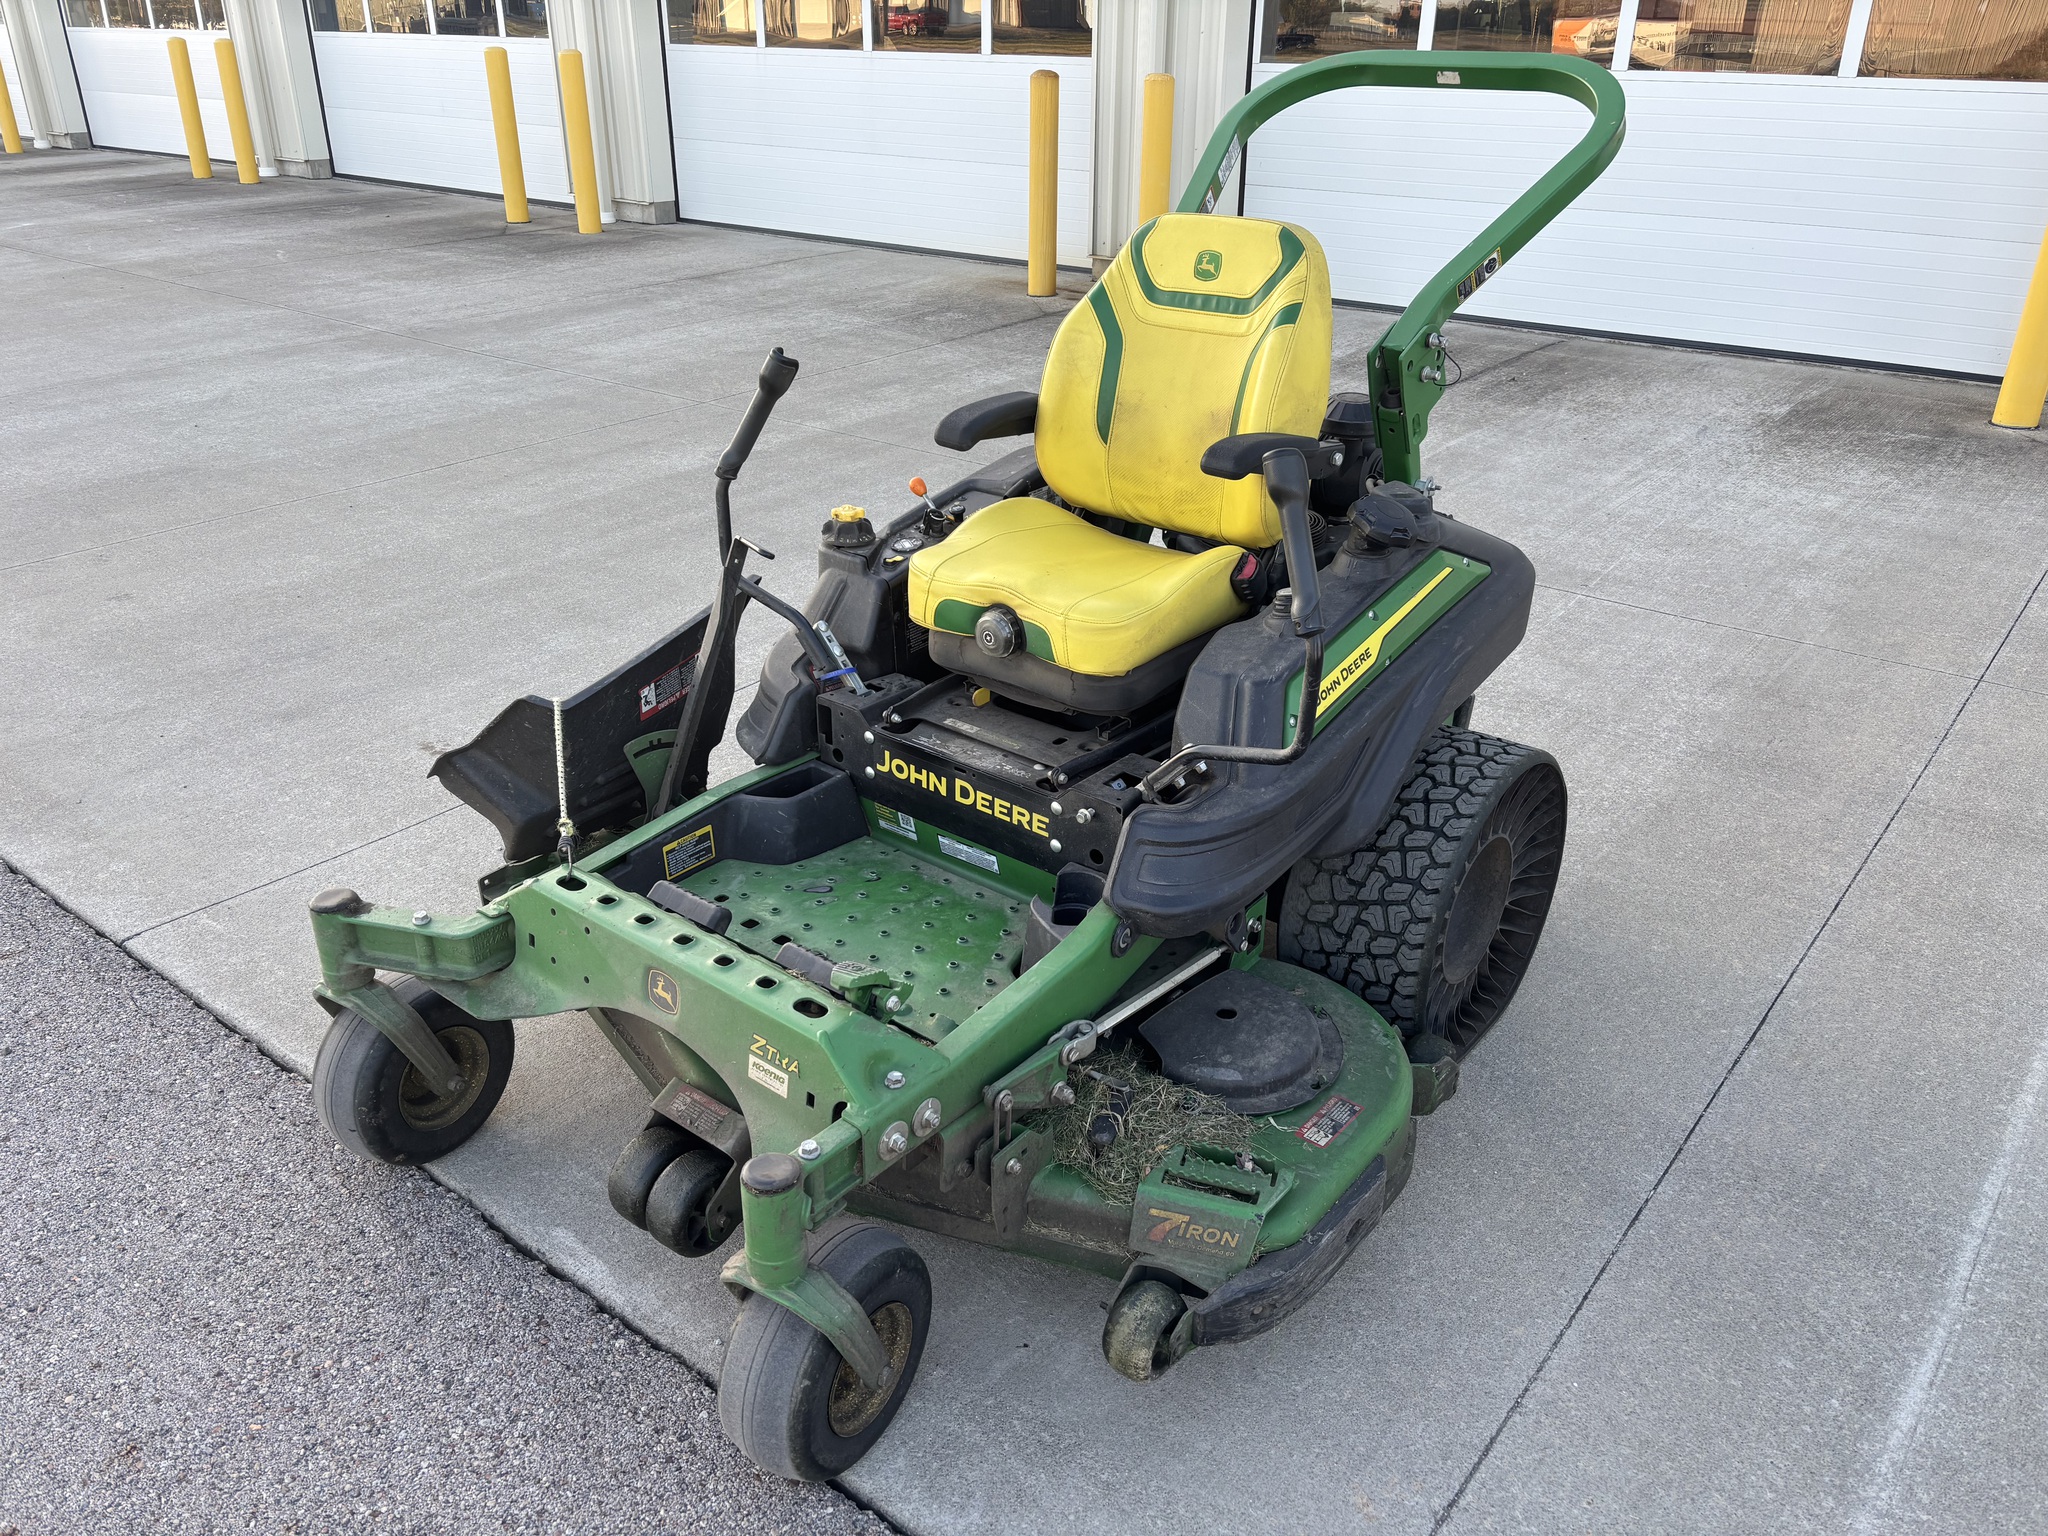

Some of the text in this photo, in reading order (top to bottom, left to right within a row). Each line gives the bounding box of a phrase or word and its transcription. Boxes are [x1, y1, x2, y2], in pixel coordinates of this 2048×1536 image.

[1316, 647, 1372, 706] JOHN DEERE
[876, 750, 947, 797] JOHN
[954, 777, 1050, 838] DEERE
